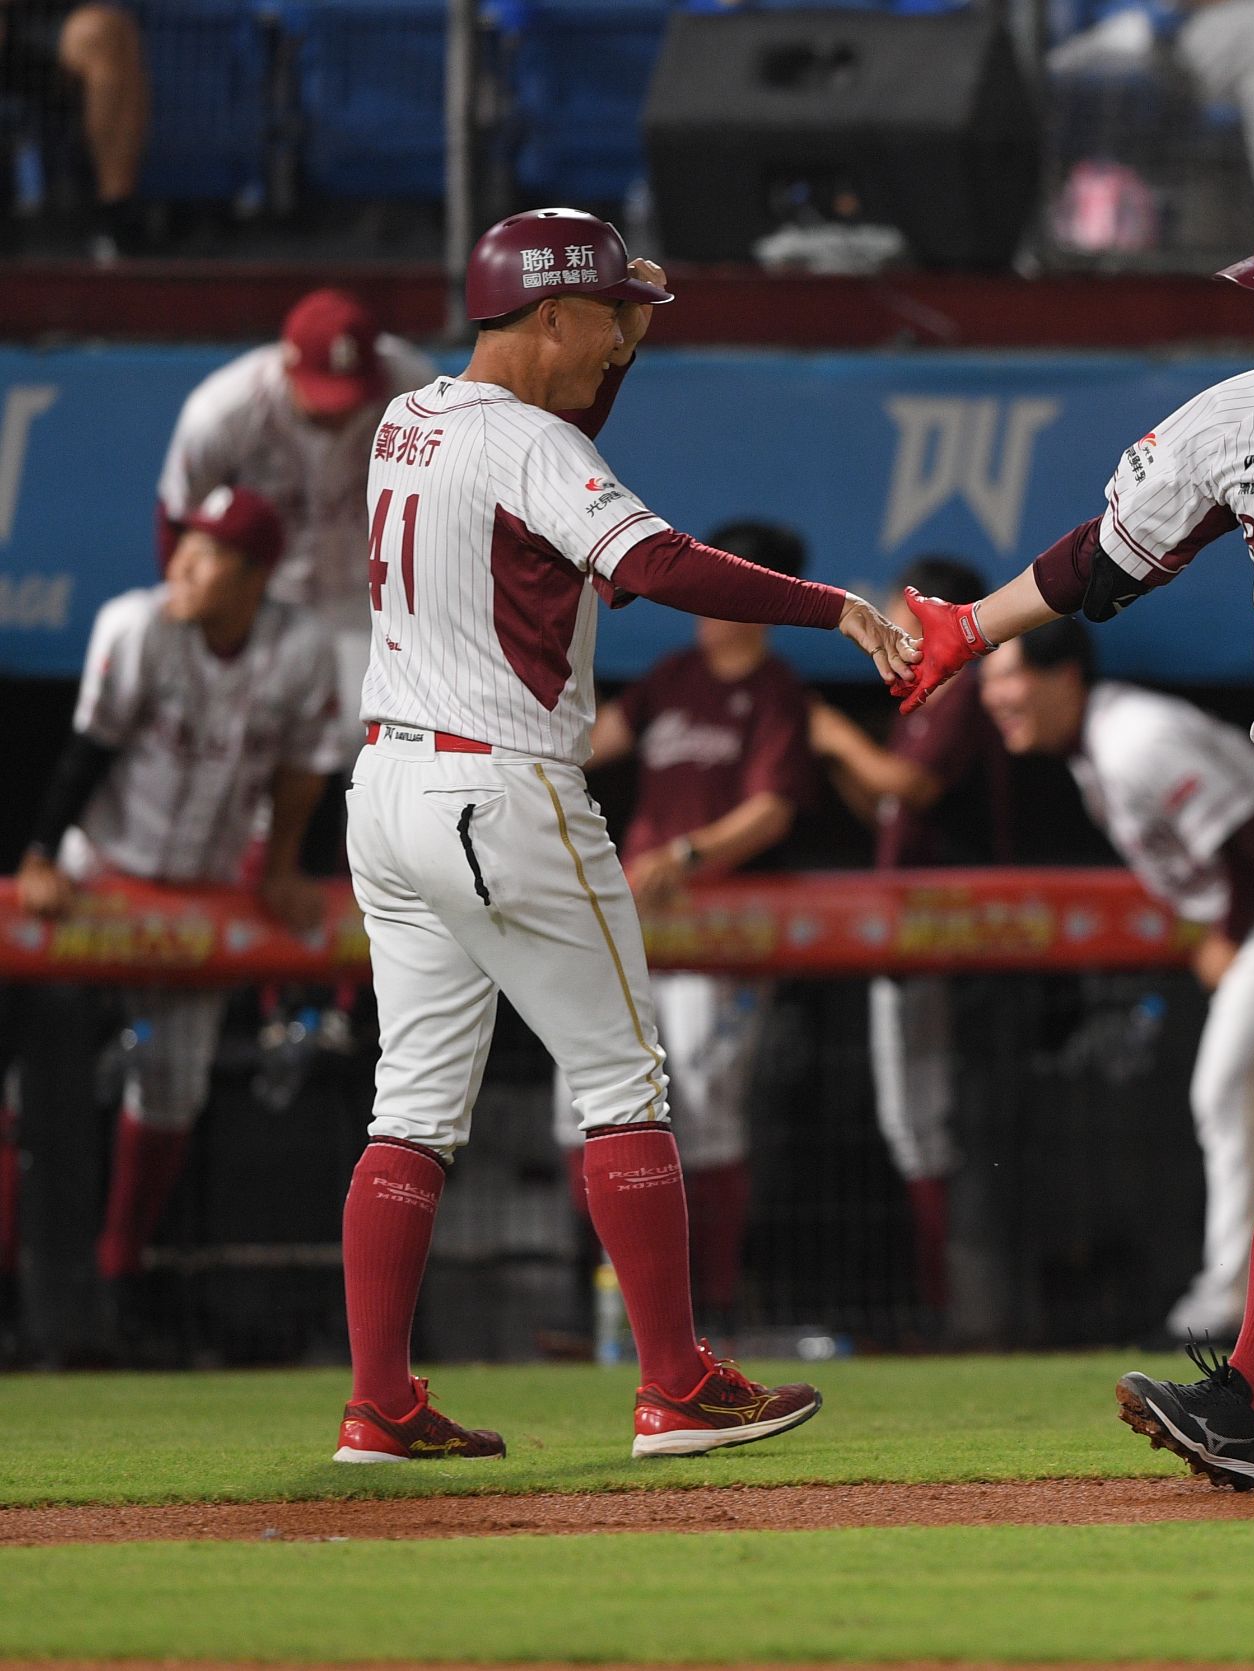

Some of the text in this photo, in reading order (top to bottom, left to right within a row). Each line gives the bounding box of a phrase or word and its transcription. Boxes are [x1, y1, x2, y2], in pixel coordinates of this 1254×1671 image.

[520, 244, 595, 272] 聯新
[522, 269, 598, 288] 國際醫院
[374, 421, 444, 467] 鄭兆行
[369, 488, 420, 617] 41
